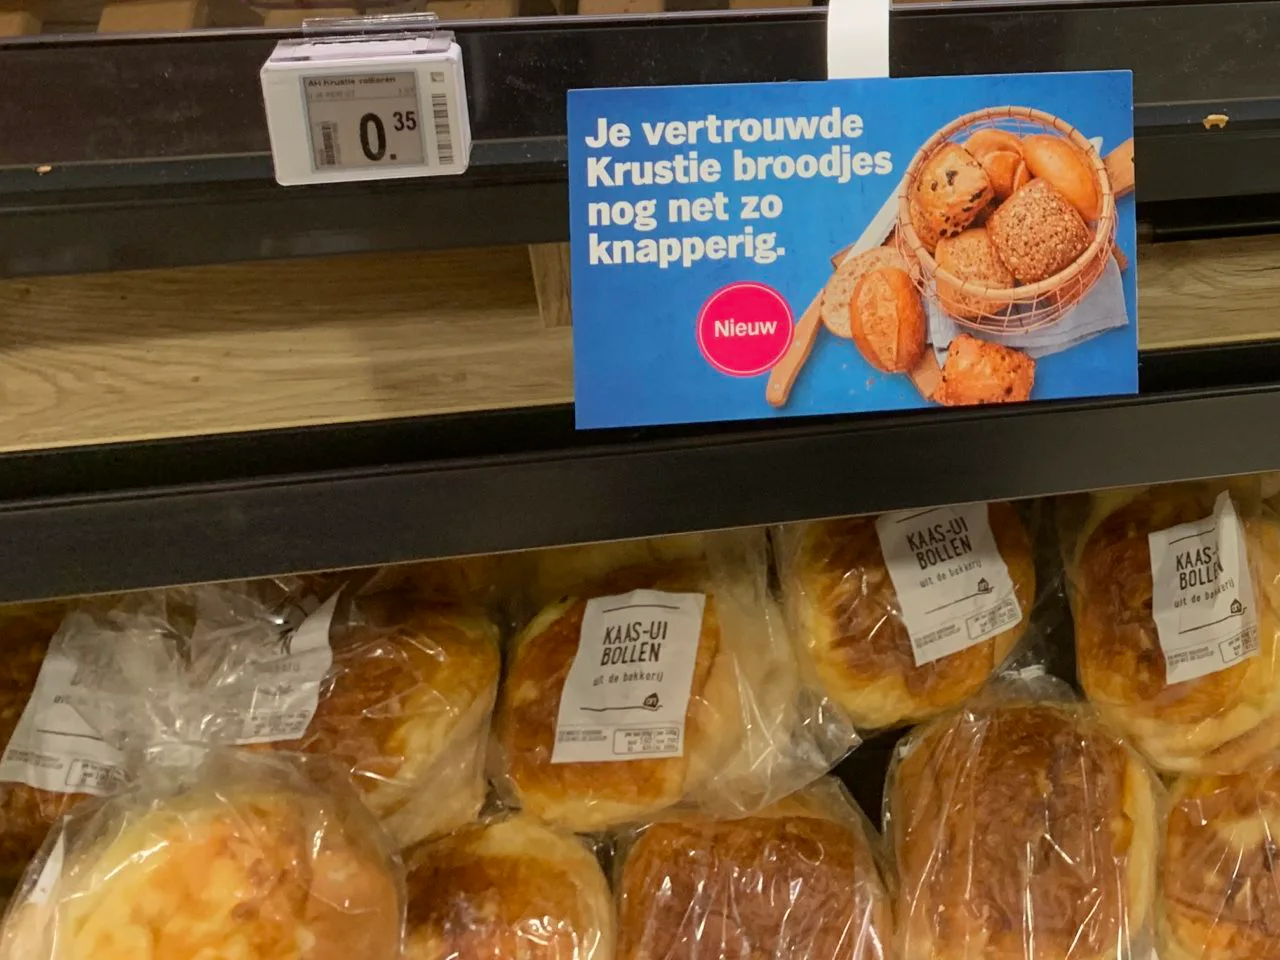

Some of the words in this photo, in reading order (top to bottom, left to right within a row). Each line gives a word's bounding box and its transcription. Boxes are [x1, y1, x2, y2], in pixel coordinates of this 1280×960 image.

[585, 117, 631, 148] Je
[643, 106, 864, 147] vertrouwde
[586, 154, 721, 187] Krustie
[733, 144, 893, 184] broodjes
[588, 197, 657, 231] nog
[668, 191, 728, 222] net
[741, 194, 783, 219] zo
[588, 226, 786, 269] knapperig.
[713, 317, 778, 339] Nieuw
[906, 516, 969, 552] KAAS-UI
[916, 535, 973, 570] BOLLEN
[1176, 545, 1218, 572] KAAS-
[1174, 597, 1187, 608] uit
[1191, 594, 1201, 604] de
[602, 621, 668, 645] KAAS-UI
[600, 642, 661, 666] BOLLEN
[608, 673, 619, 684] de
